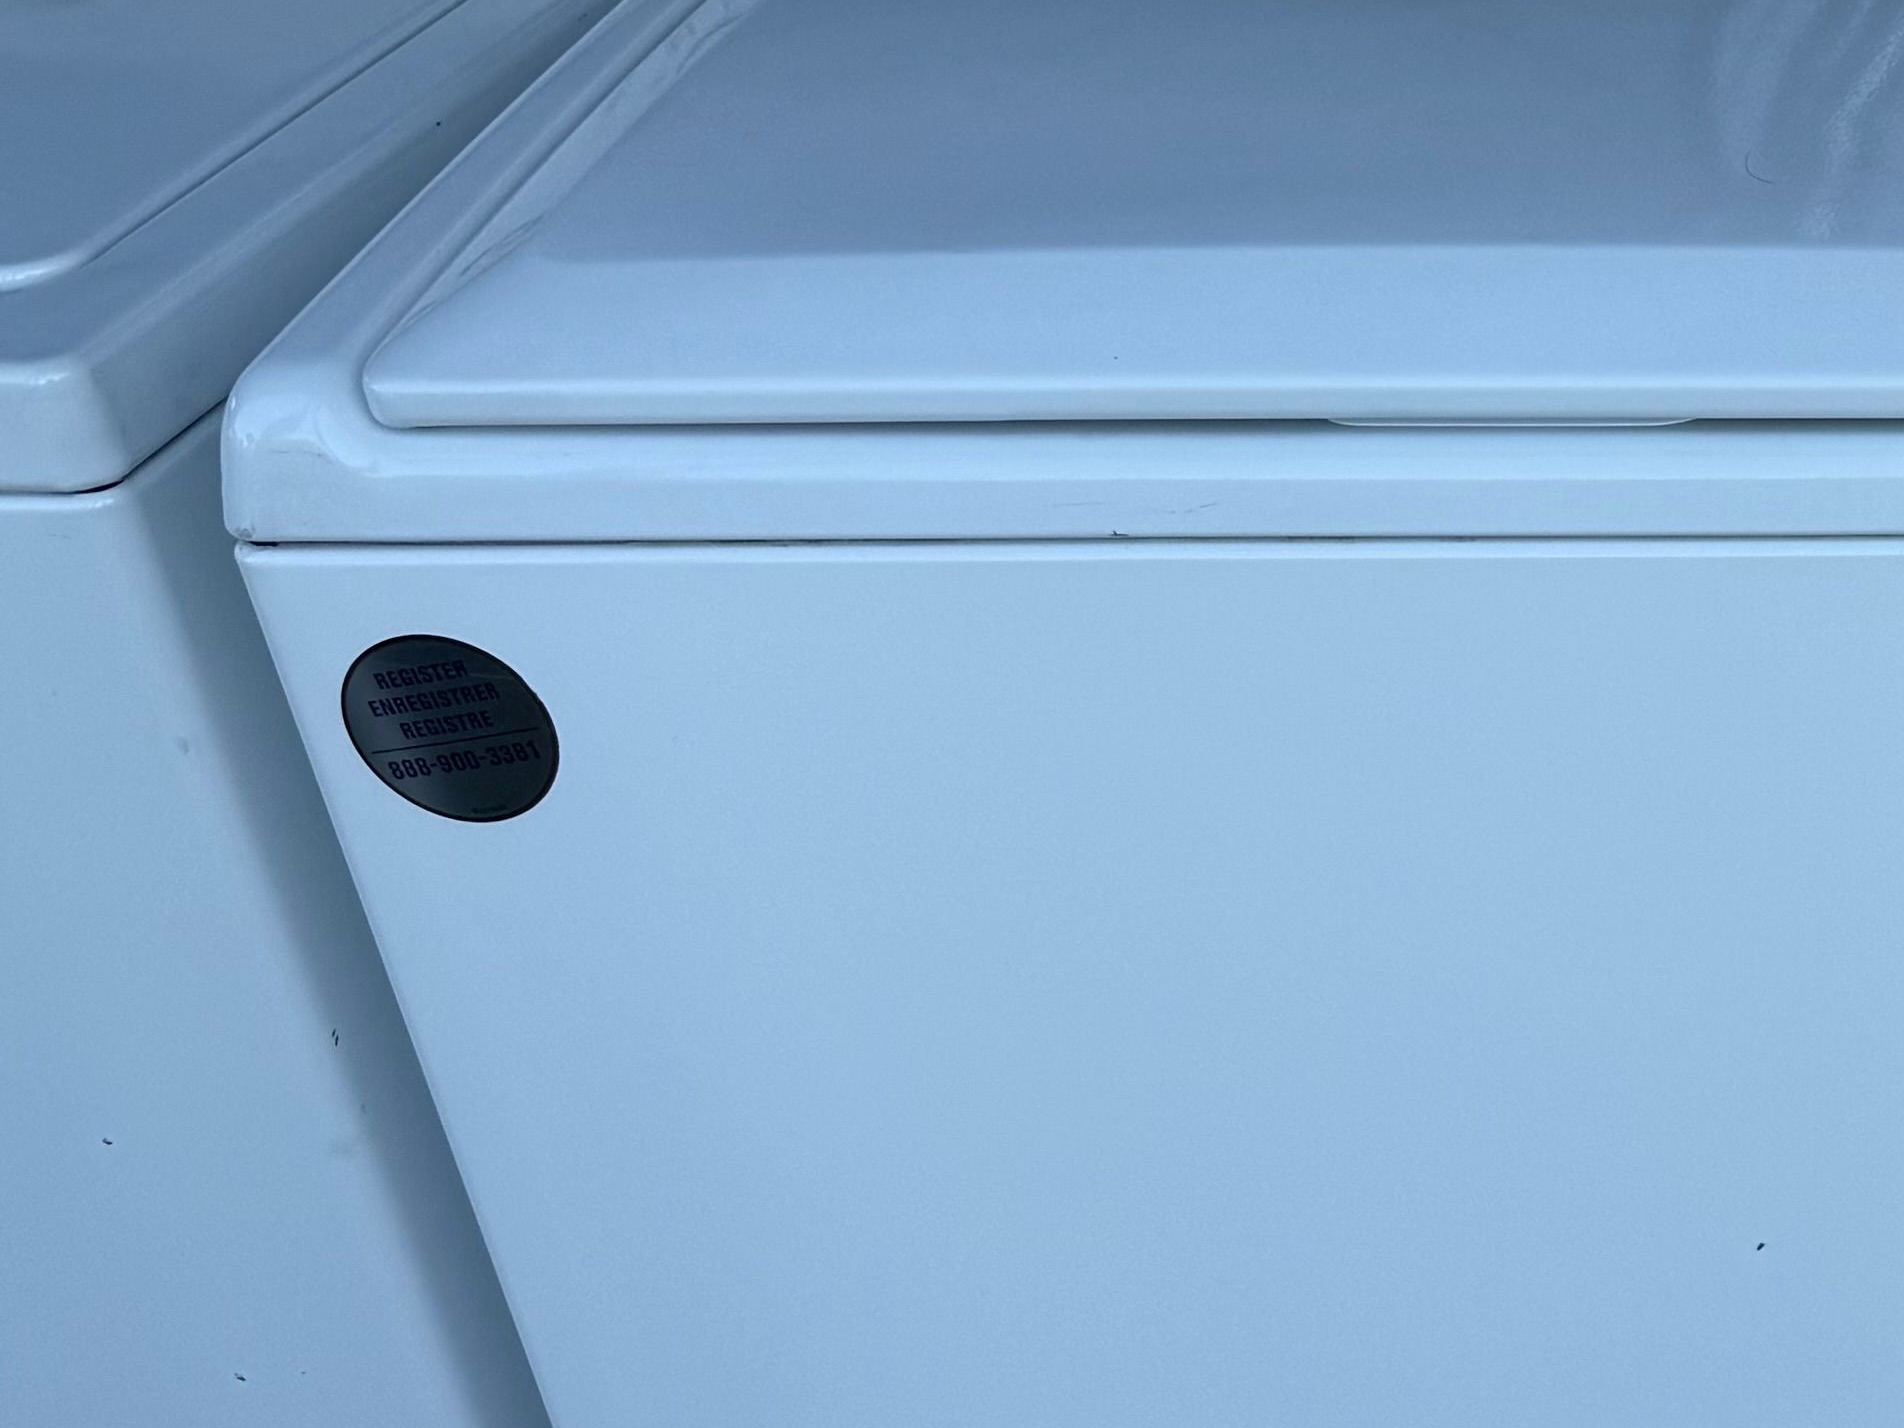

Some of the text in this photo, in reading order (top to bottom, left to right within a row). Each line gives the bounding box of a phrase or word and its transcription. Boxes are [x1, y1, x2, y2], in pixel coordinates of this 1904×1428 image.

[372, 660, 468, 690] REGISTER
[367, 682, 500, 718] ENREGISTRER
[400, 710, 495, 740] REGISTRE
[388, 739, 542, 780] 888-900-3381
